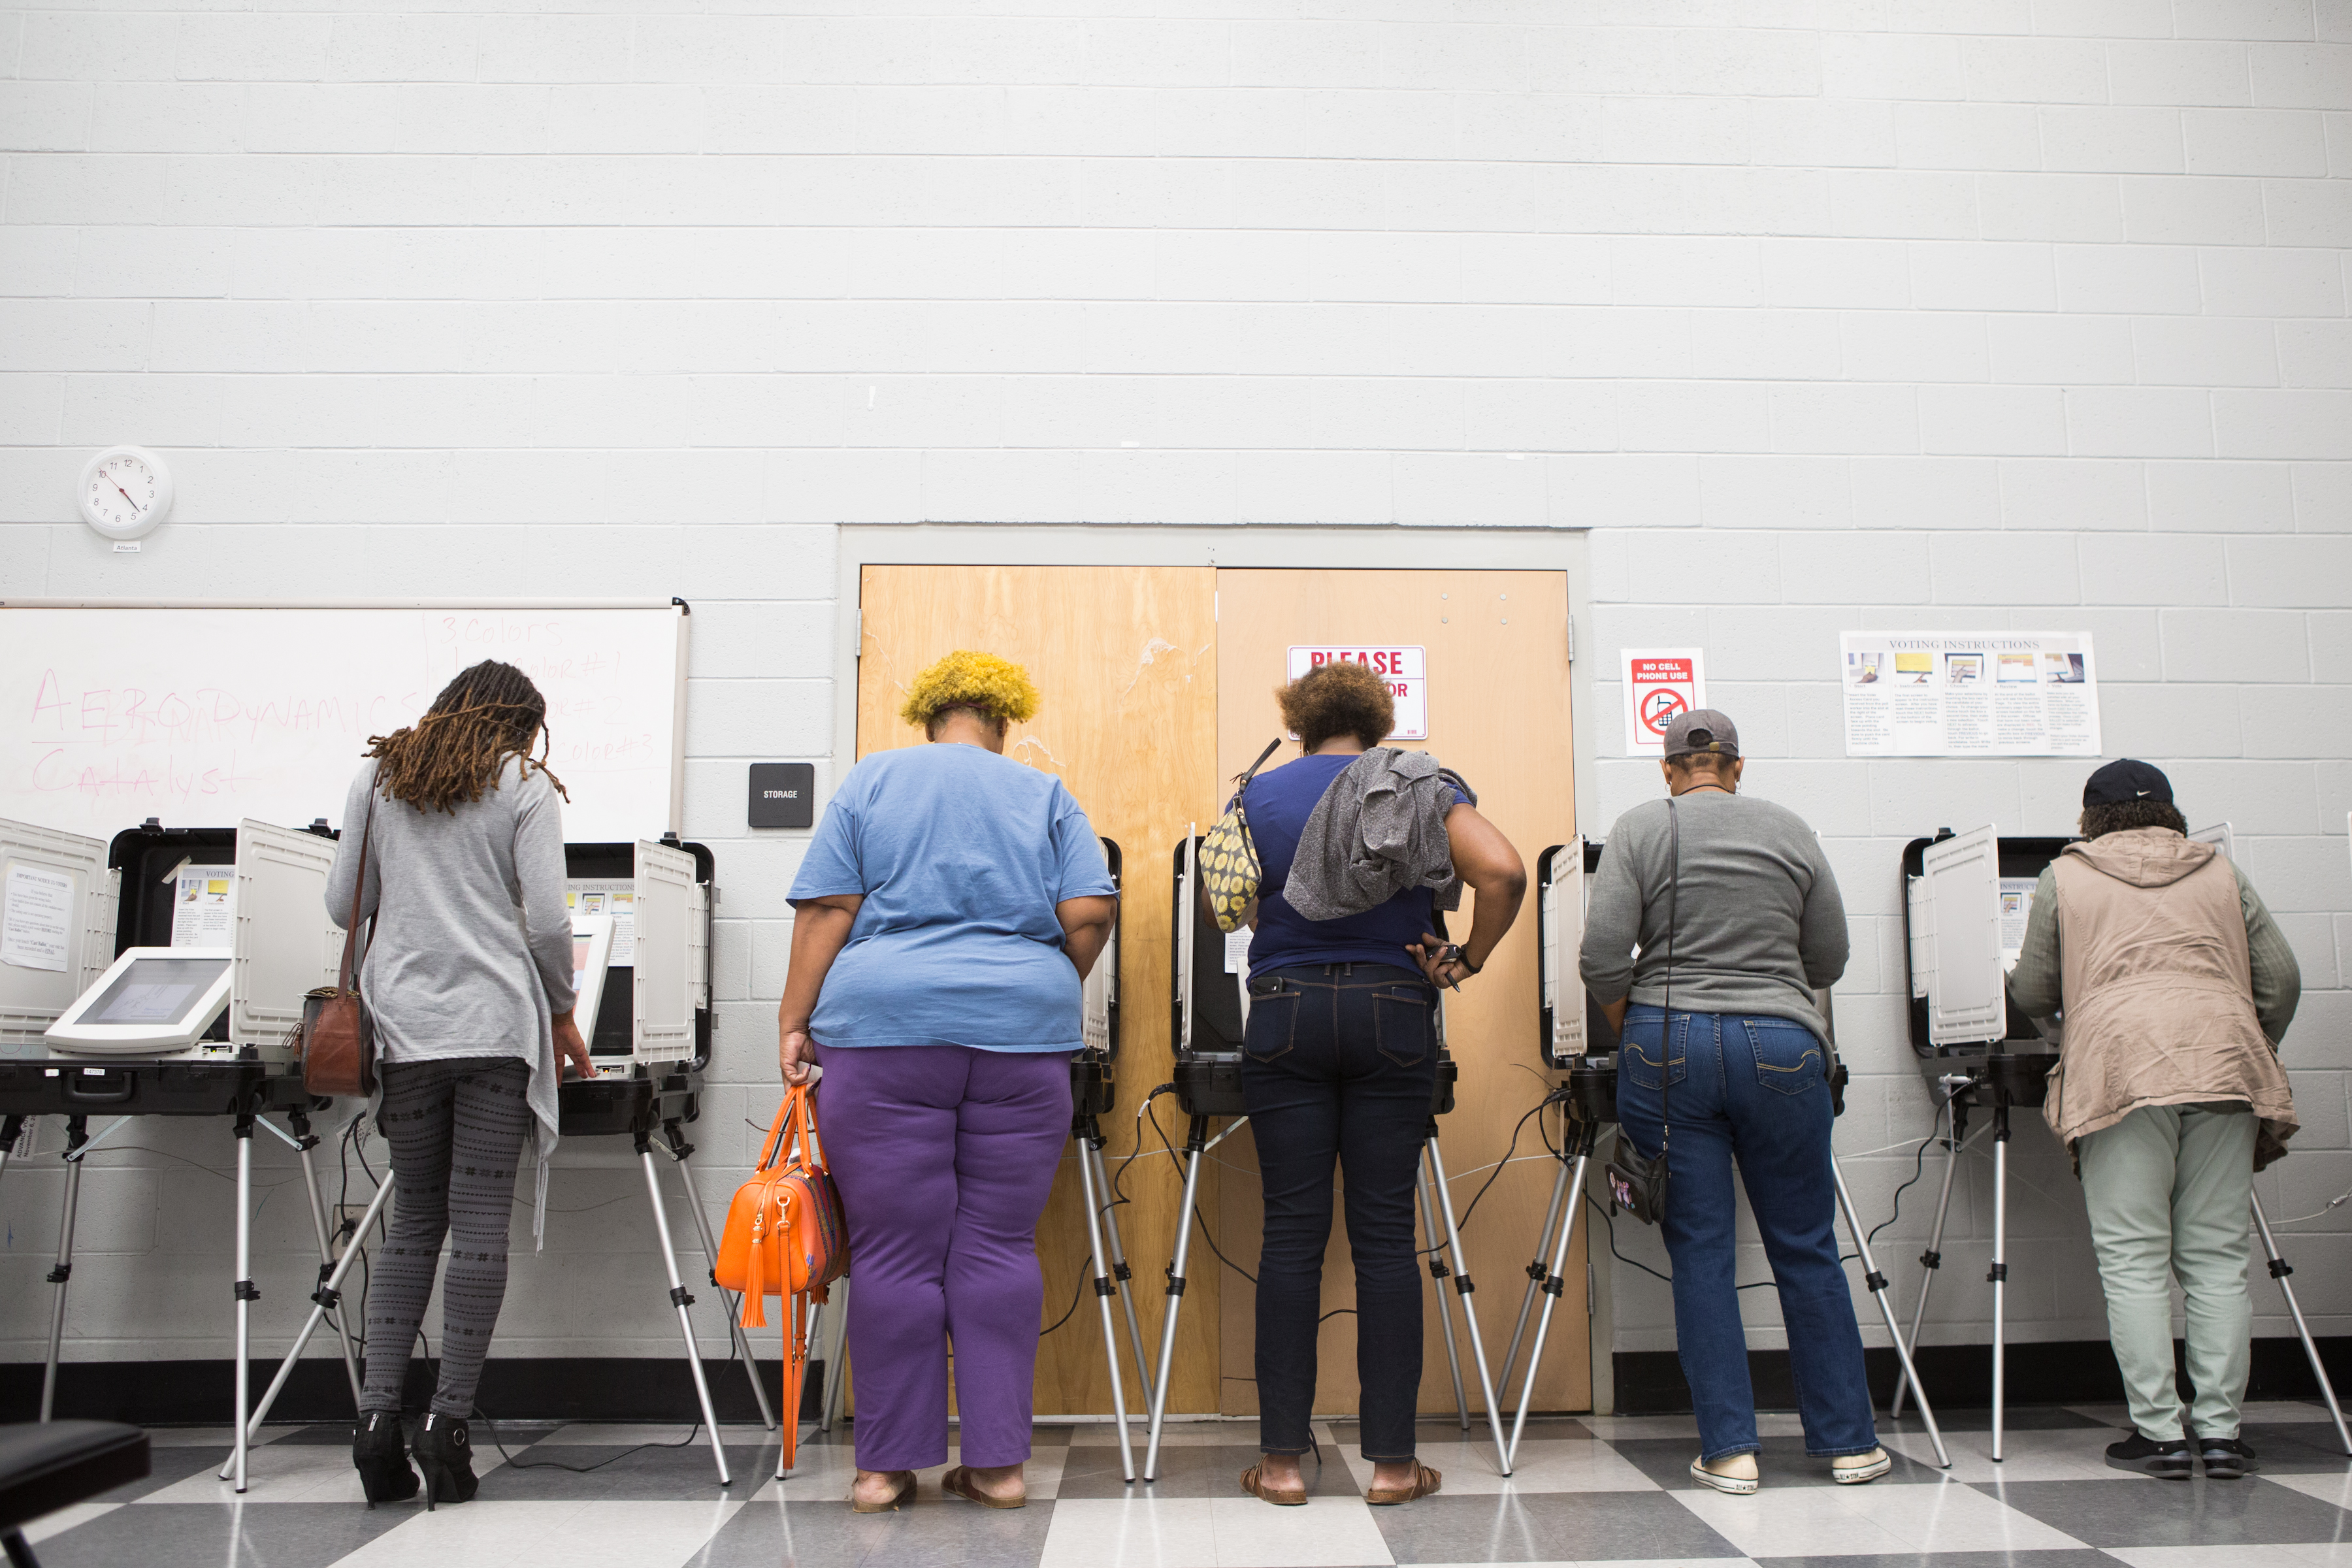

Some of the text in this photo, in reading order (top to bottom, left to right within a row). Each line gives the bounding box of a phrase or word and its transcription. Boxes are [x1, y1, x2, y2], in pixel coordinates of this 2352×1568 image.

[441, 617, 456, 644] 3
[1890, 641, 2040, 649] VOTING INSTRUCTIONS
[17, 873, 37, 881] IMPORTANT
[17, 1130, 26, 1158] ADVANCE
[24, 1129, 33, 1157] November
